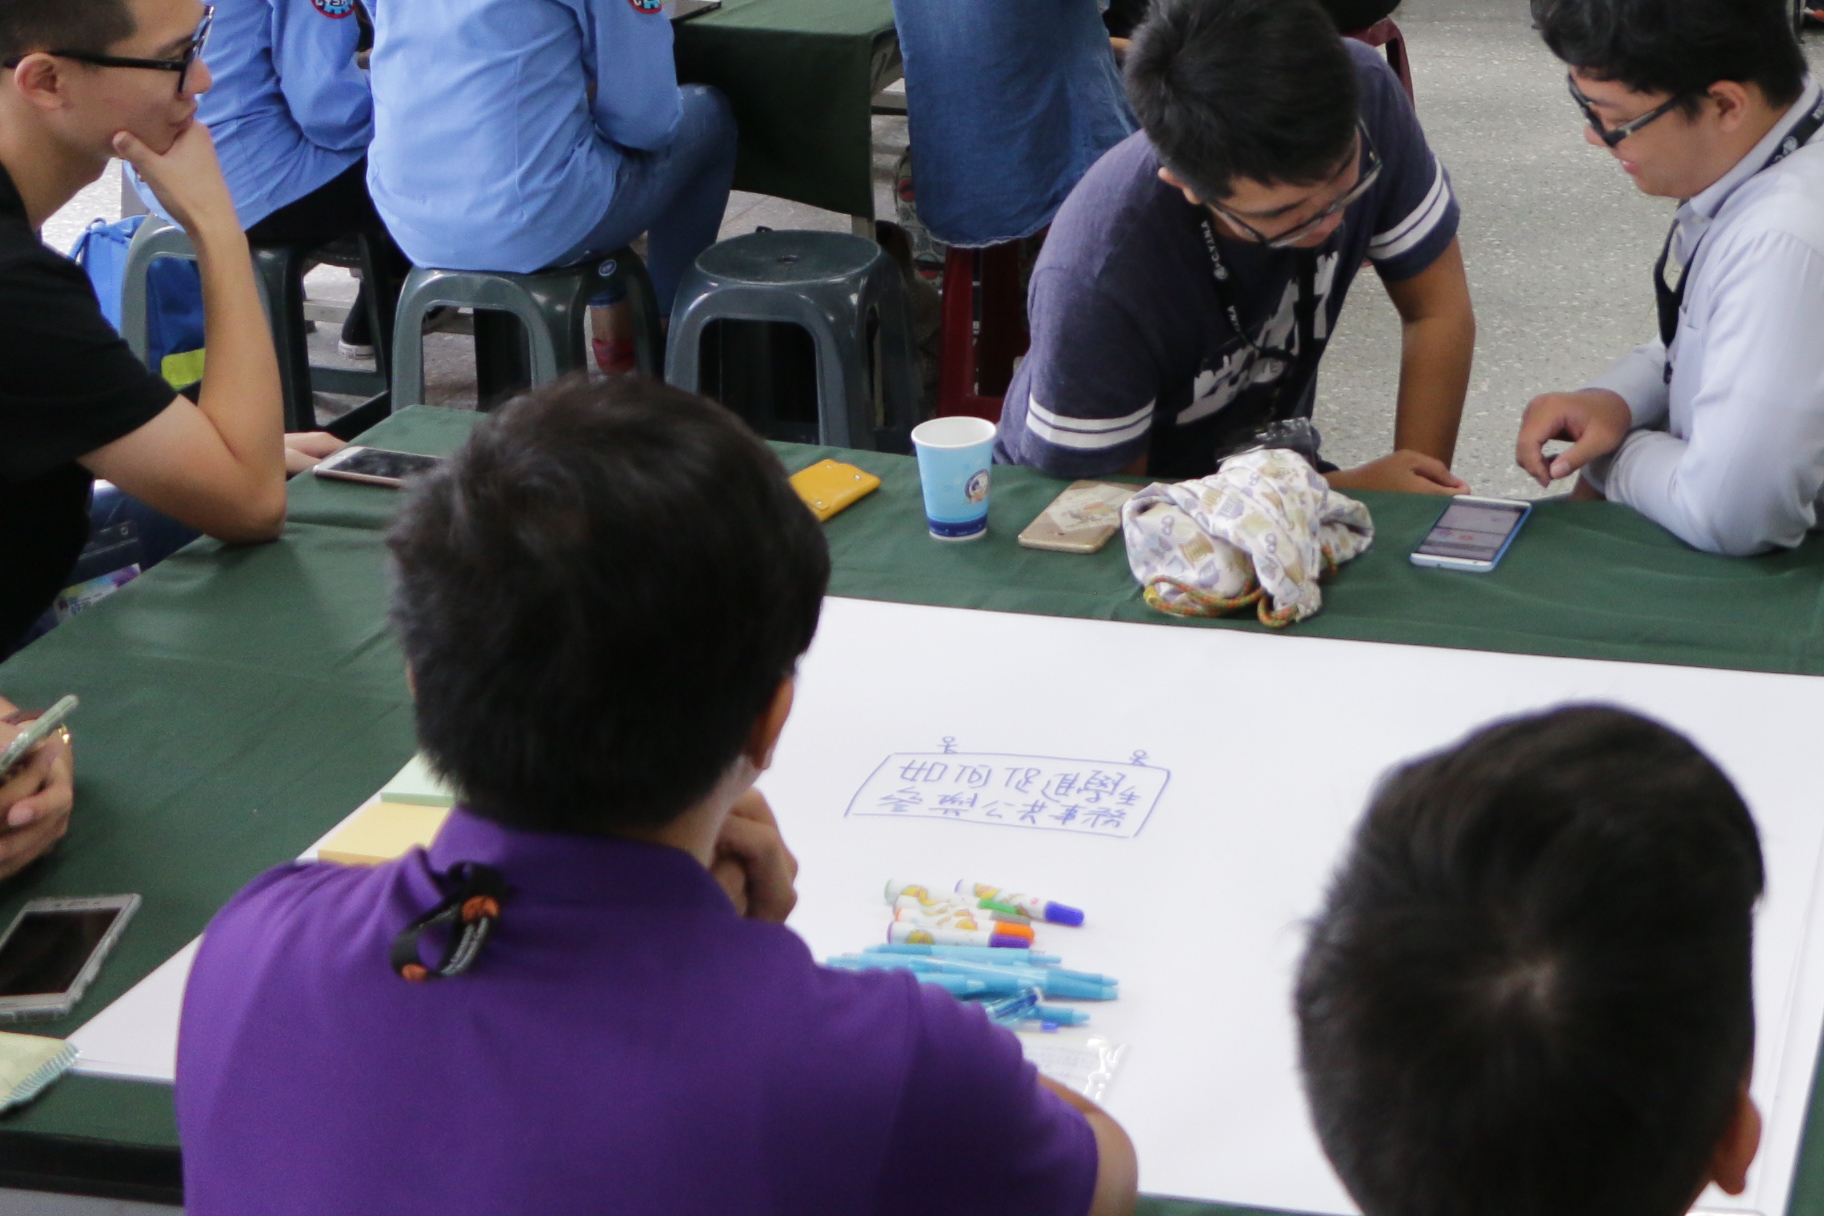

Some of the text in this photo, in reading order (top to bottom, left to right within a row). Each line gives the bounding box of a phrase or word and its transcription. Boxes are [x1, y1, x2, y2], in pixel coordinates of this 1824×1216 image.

[899, 759, 1142, 807] 如何促進學生
[876, 786, 1127, 830] 參與公共事務
